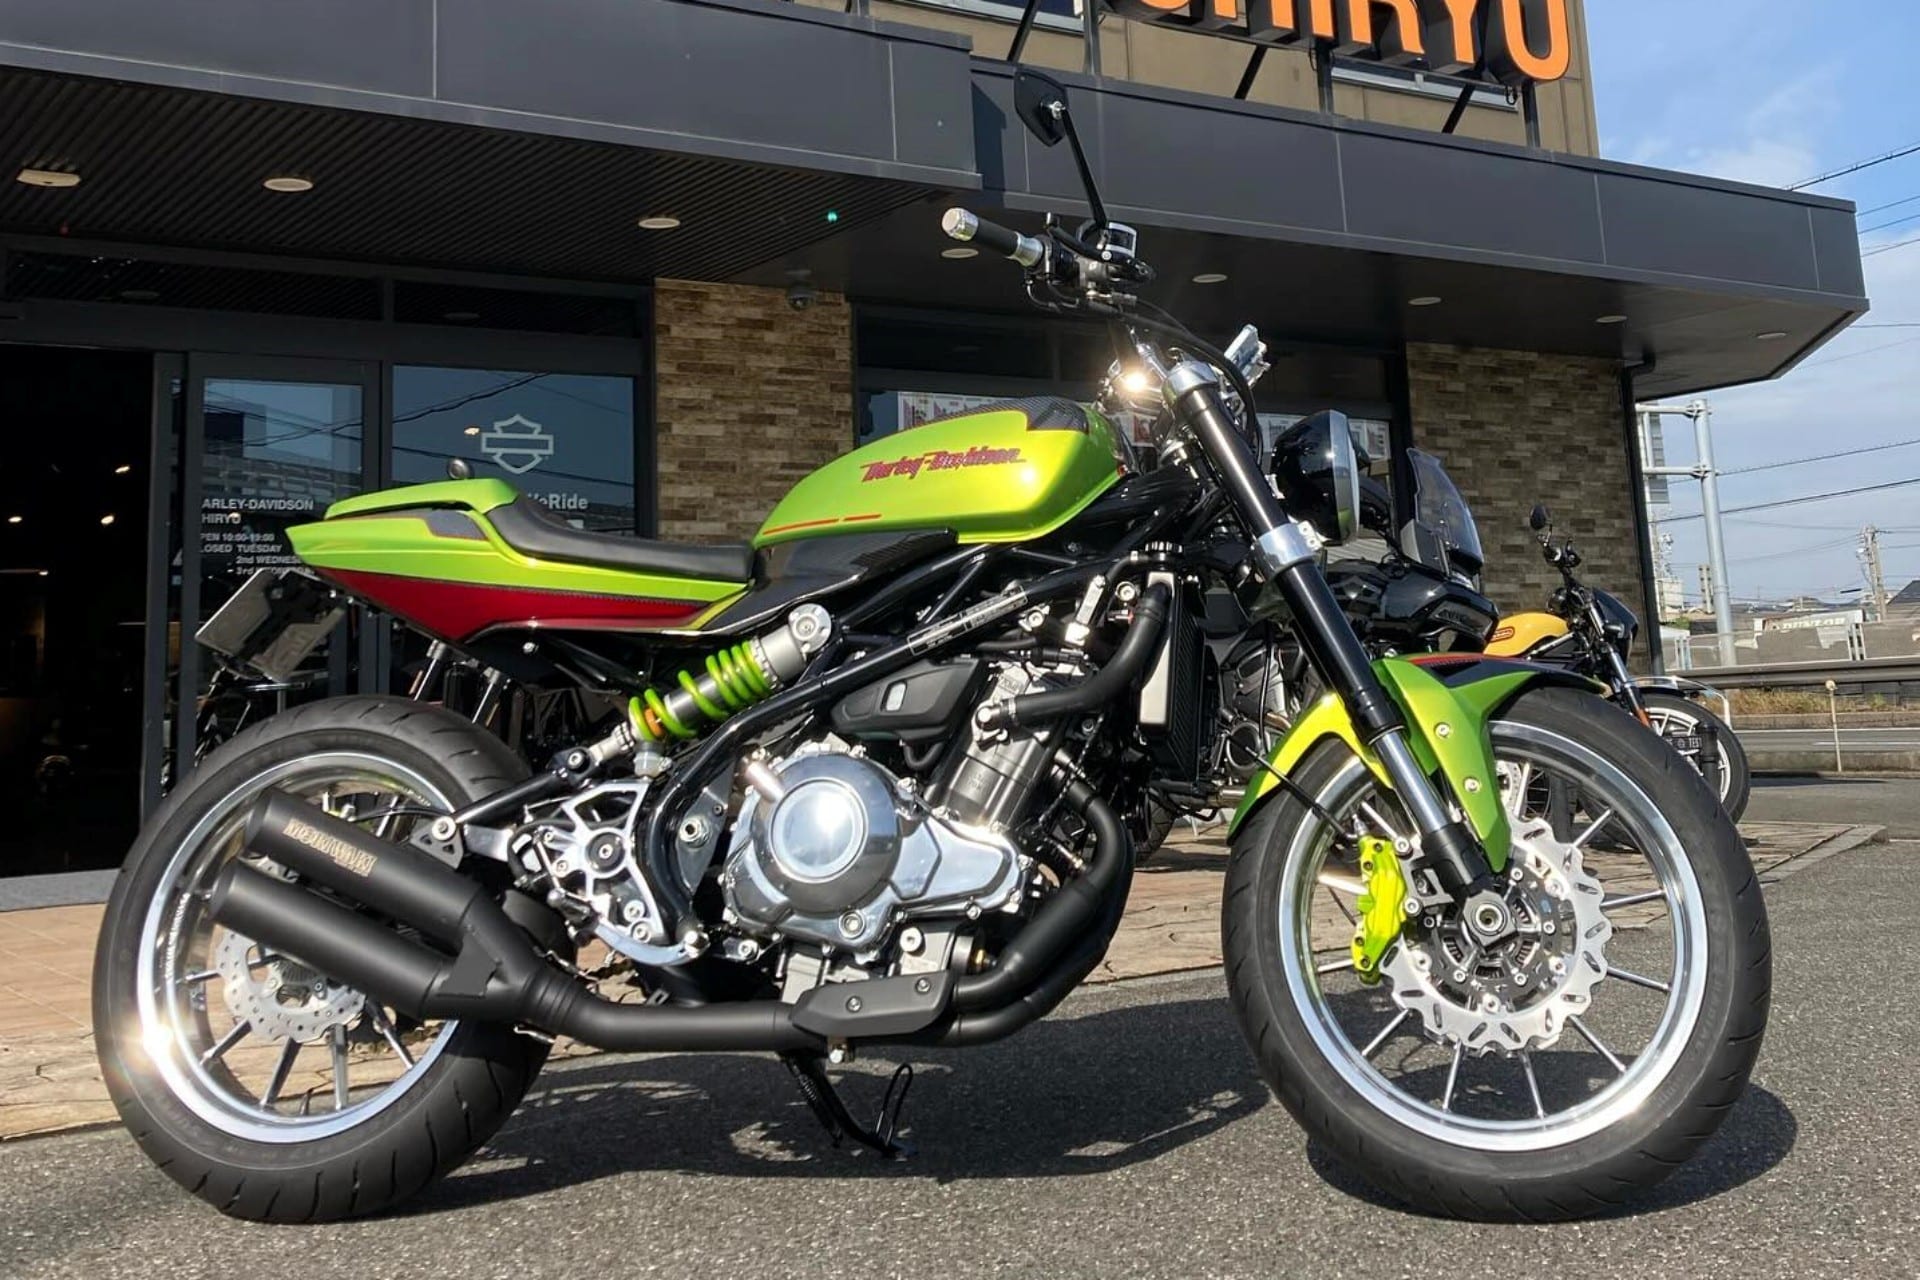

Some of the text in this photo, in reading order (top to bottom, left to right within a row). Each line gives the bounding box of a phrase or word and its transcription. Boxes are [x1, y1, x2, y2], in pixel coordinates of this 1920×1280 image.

[200, 544, 282, 553] OSED TUESDAY
[235, 556, 254, 564] 2nd
[235, 567, 254, 576] 3rd
